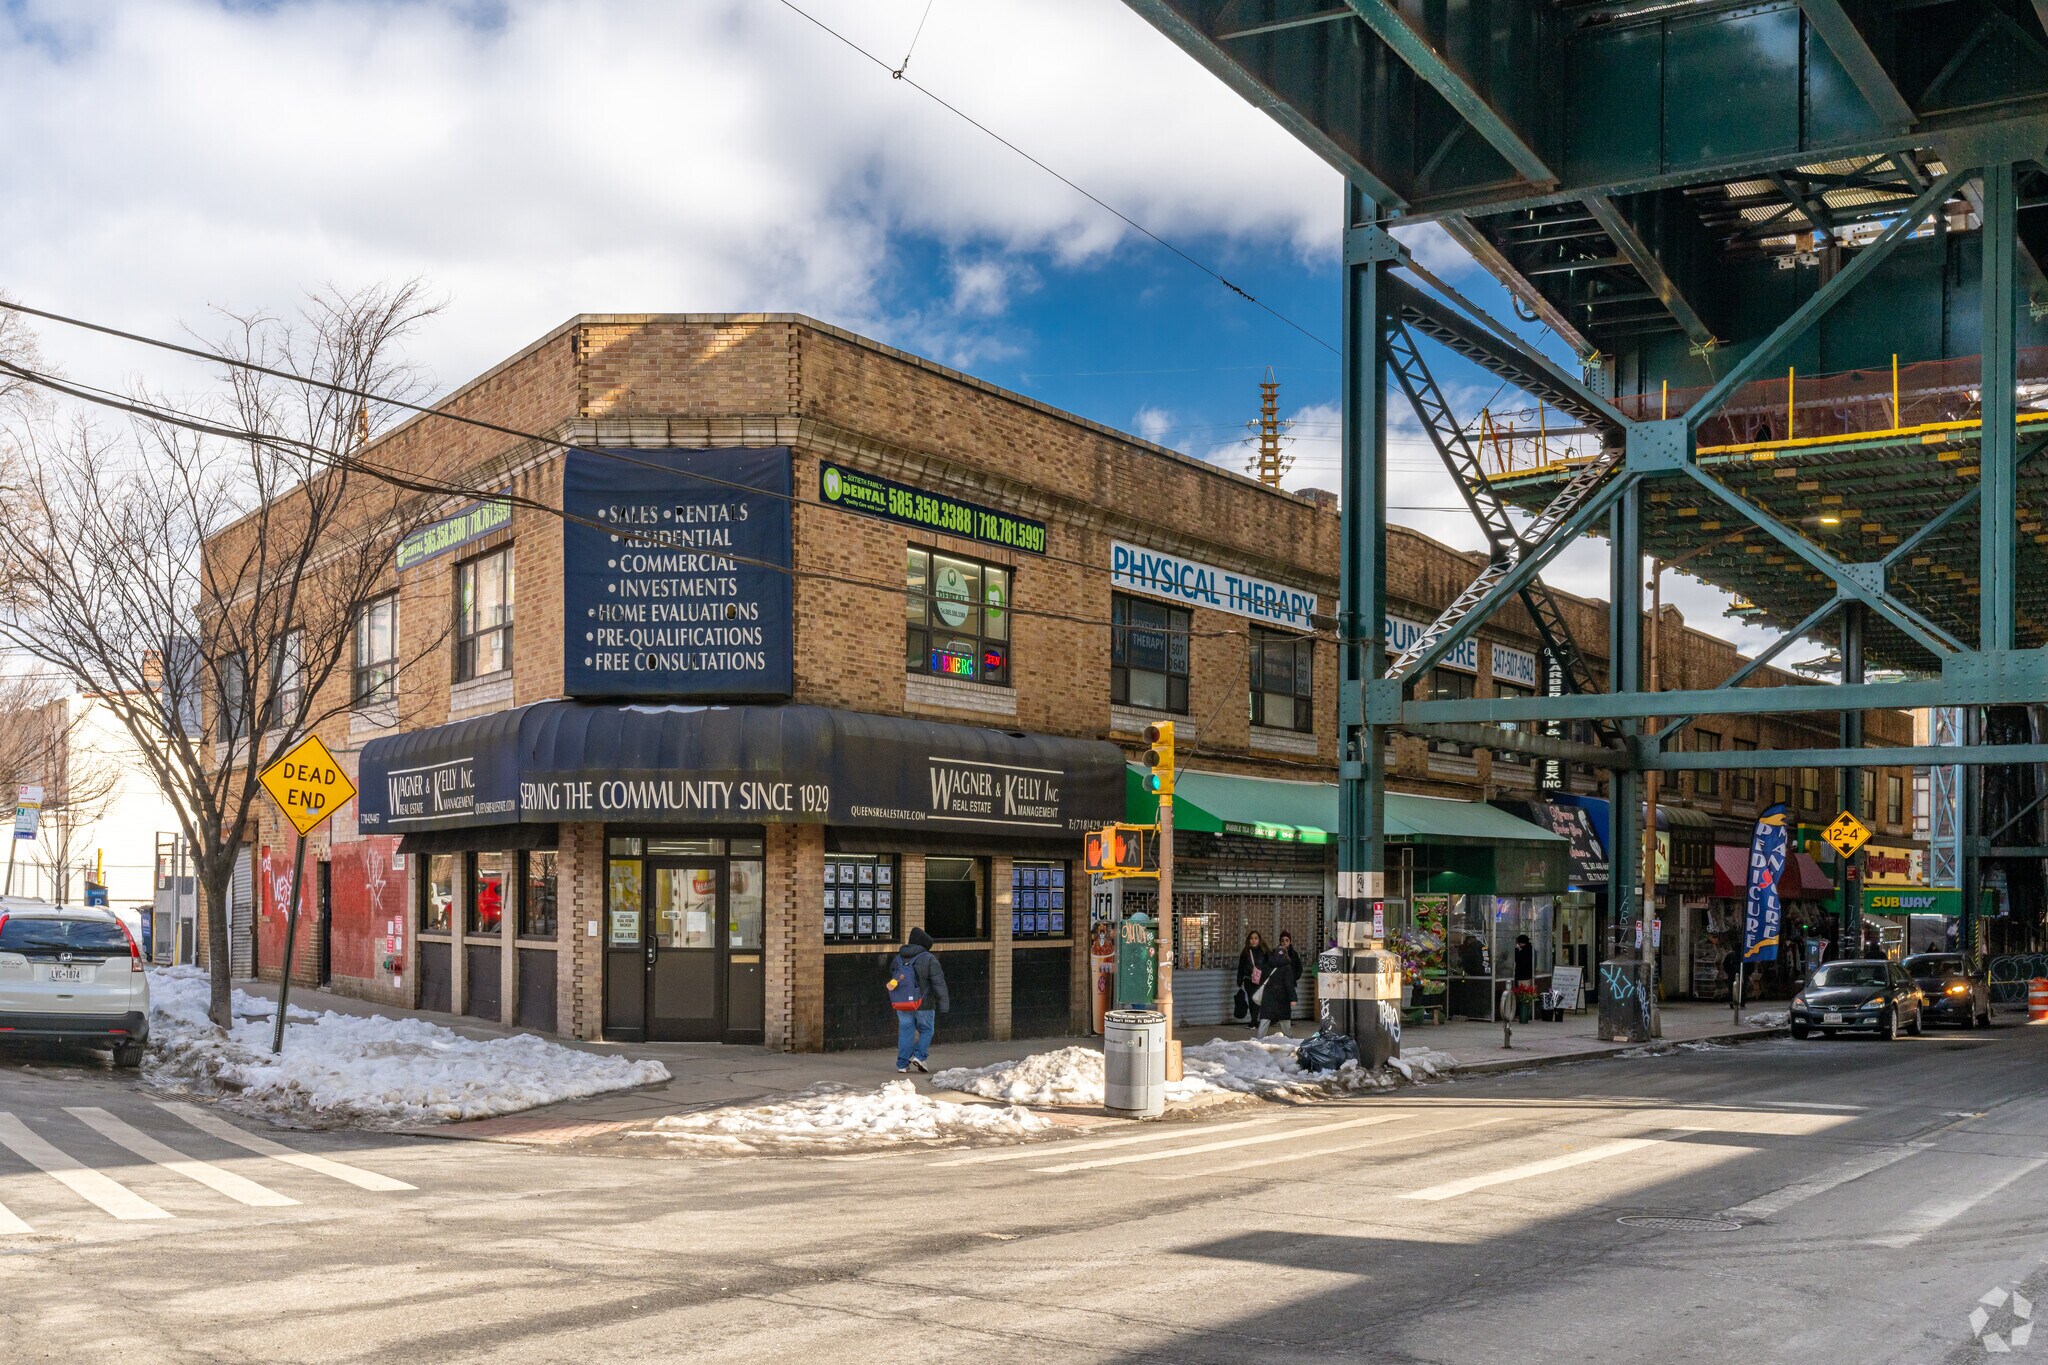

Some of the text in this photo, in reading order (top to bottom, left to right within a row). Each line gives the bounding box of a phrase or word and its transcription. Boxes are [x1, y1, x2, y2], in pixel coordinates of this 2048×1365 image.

[843, 482, 887, 506] DENTAL
[609, 504, 658, 524] SALES
[674, 503, 748, 523] RENTALS
[889, 487, 1044, 552] 585.358.3388 718.781.5997
[624, 528, 733, 548] RESIDENTIAL
[620, 553, 737, 573] COMMERCIAL
[620, 577, 737, 598] INVESTMENTS
[1113, 545, 1315, 627] PHYSICAL THERAPY
[599, 602, 759, 622] HOME EVALUATIONS
[597, 626, 763, 650] PRE-QUALIFICATIONS
[1132, 632, 1165, 651] THERAPY
[1171, 643, 1184, 656] 507
[595, 651, 766, 671] FREE CONSULTATIONS
[1493, 647, 1534, 681] 347-507-0642
[283, 762, 336, 785] DEAD
[389, 775, 424, 816] WAGNER
[425, 778, 430, 794] &
[434, 768, 457, 812] KELLY
[930, 767, 992, 811] WAGNER
[995, 784, 1001, 798] &
[1004, 774, 1042, 816] KELLY
[1542, 780, 1562, 788] INC
[287, 788, 326, 809] END
[400, 795, 475, 815] REAL ESTATE MANAGEMENT
[520, 780, 830, 813] SERVING THE COMMUNITY SINCE 1929
[850, 805, 926, 821] QUEENSREALESTATE.COM
[952, 800, 1059, 819] REAL ESTATE MANAGEMENT
[1225, 823, 1242, 833] BUBBLE
[1828, 827, 1863, 841] 12'-4"
[1746, 822, 1773, 949] PEDICURE
[1871, 896, 1937, 909] SUBWAY
[51, 969, 80, 979] LVC-1874
